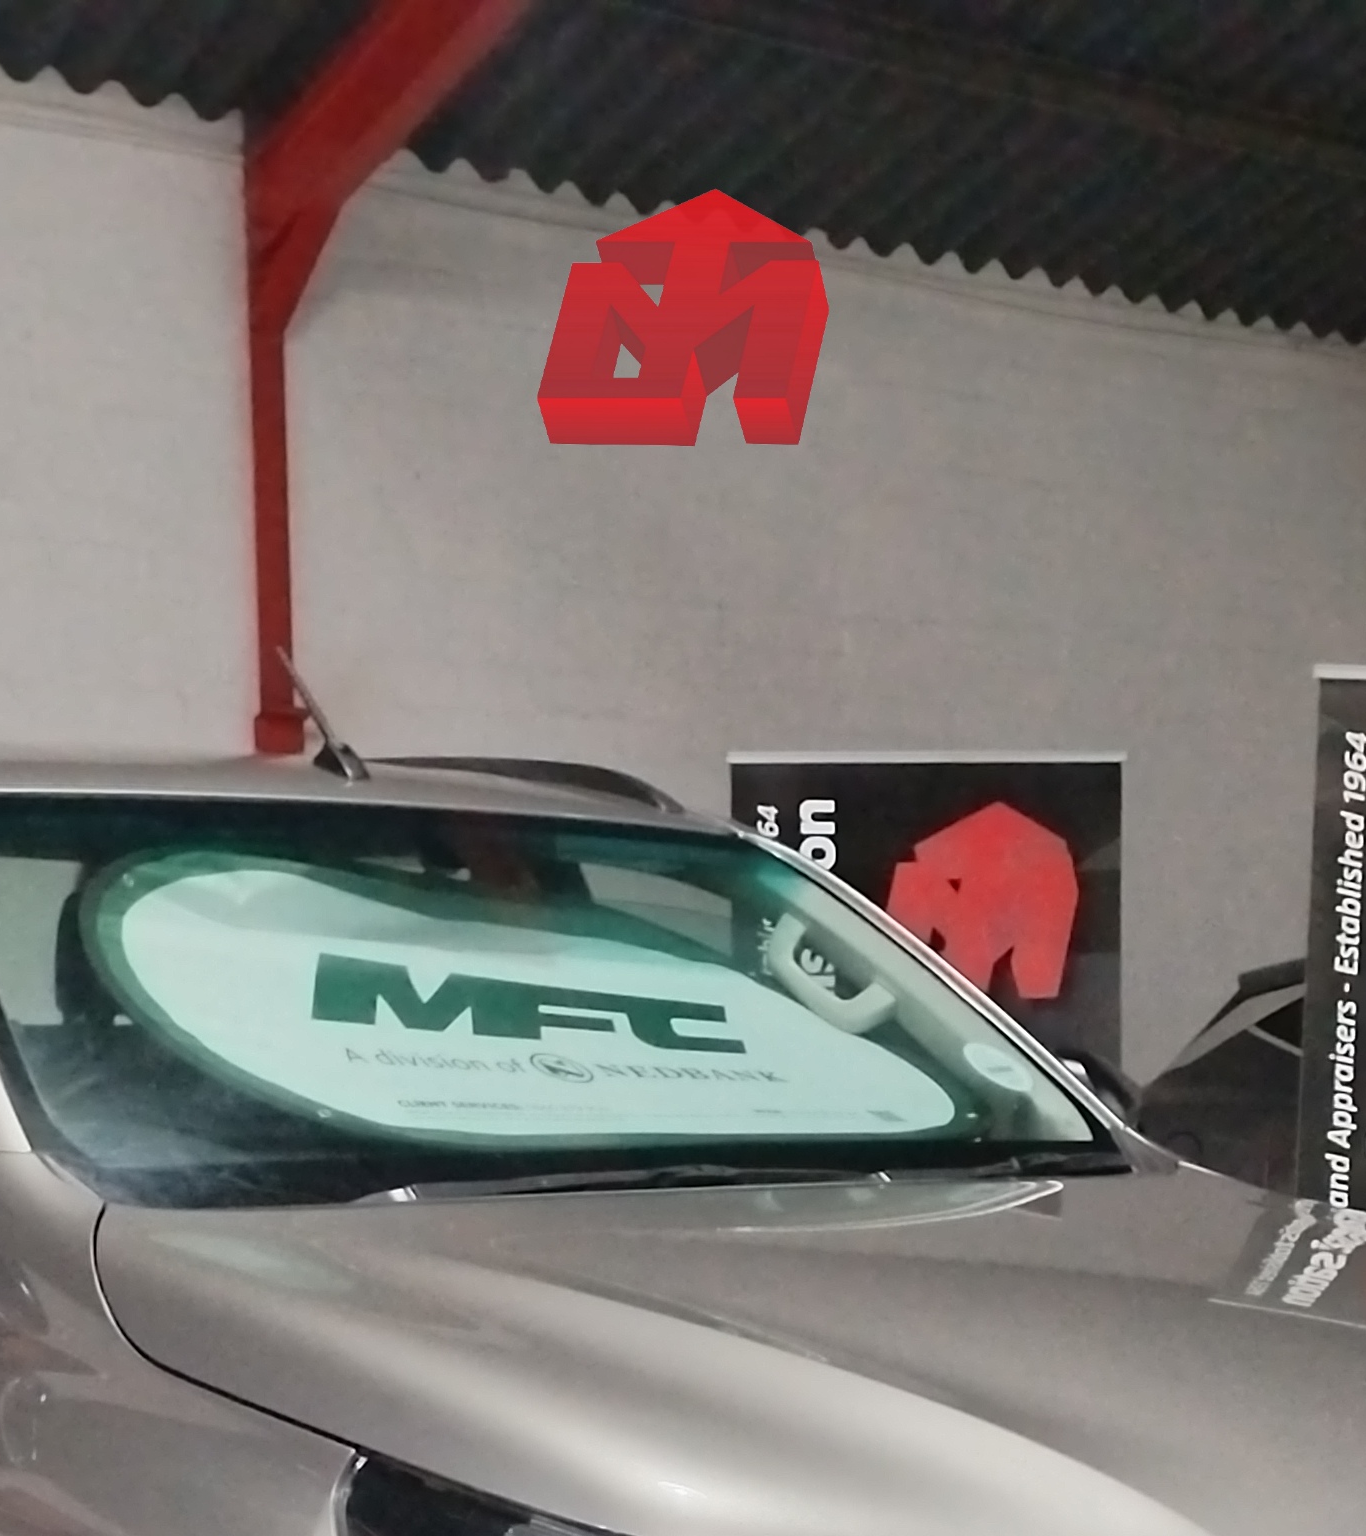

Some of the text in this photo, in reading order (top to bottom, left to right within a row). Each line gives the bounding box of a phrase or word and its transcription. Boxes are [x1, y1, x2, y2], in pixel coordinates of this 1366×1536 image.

[1334, 810, 1365, 976] Established
[311, 953, 747, 1054] MFC
[344, 1046, 788, 1084] A division of NEDBANK
[1327, 1000, 1358, 1149] Appraisers
